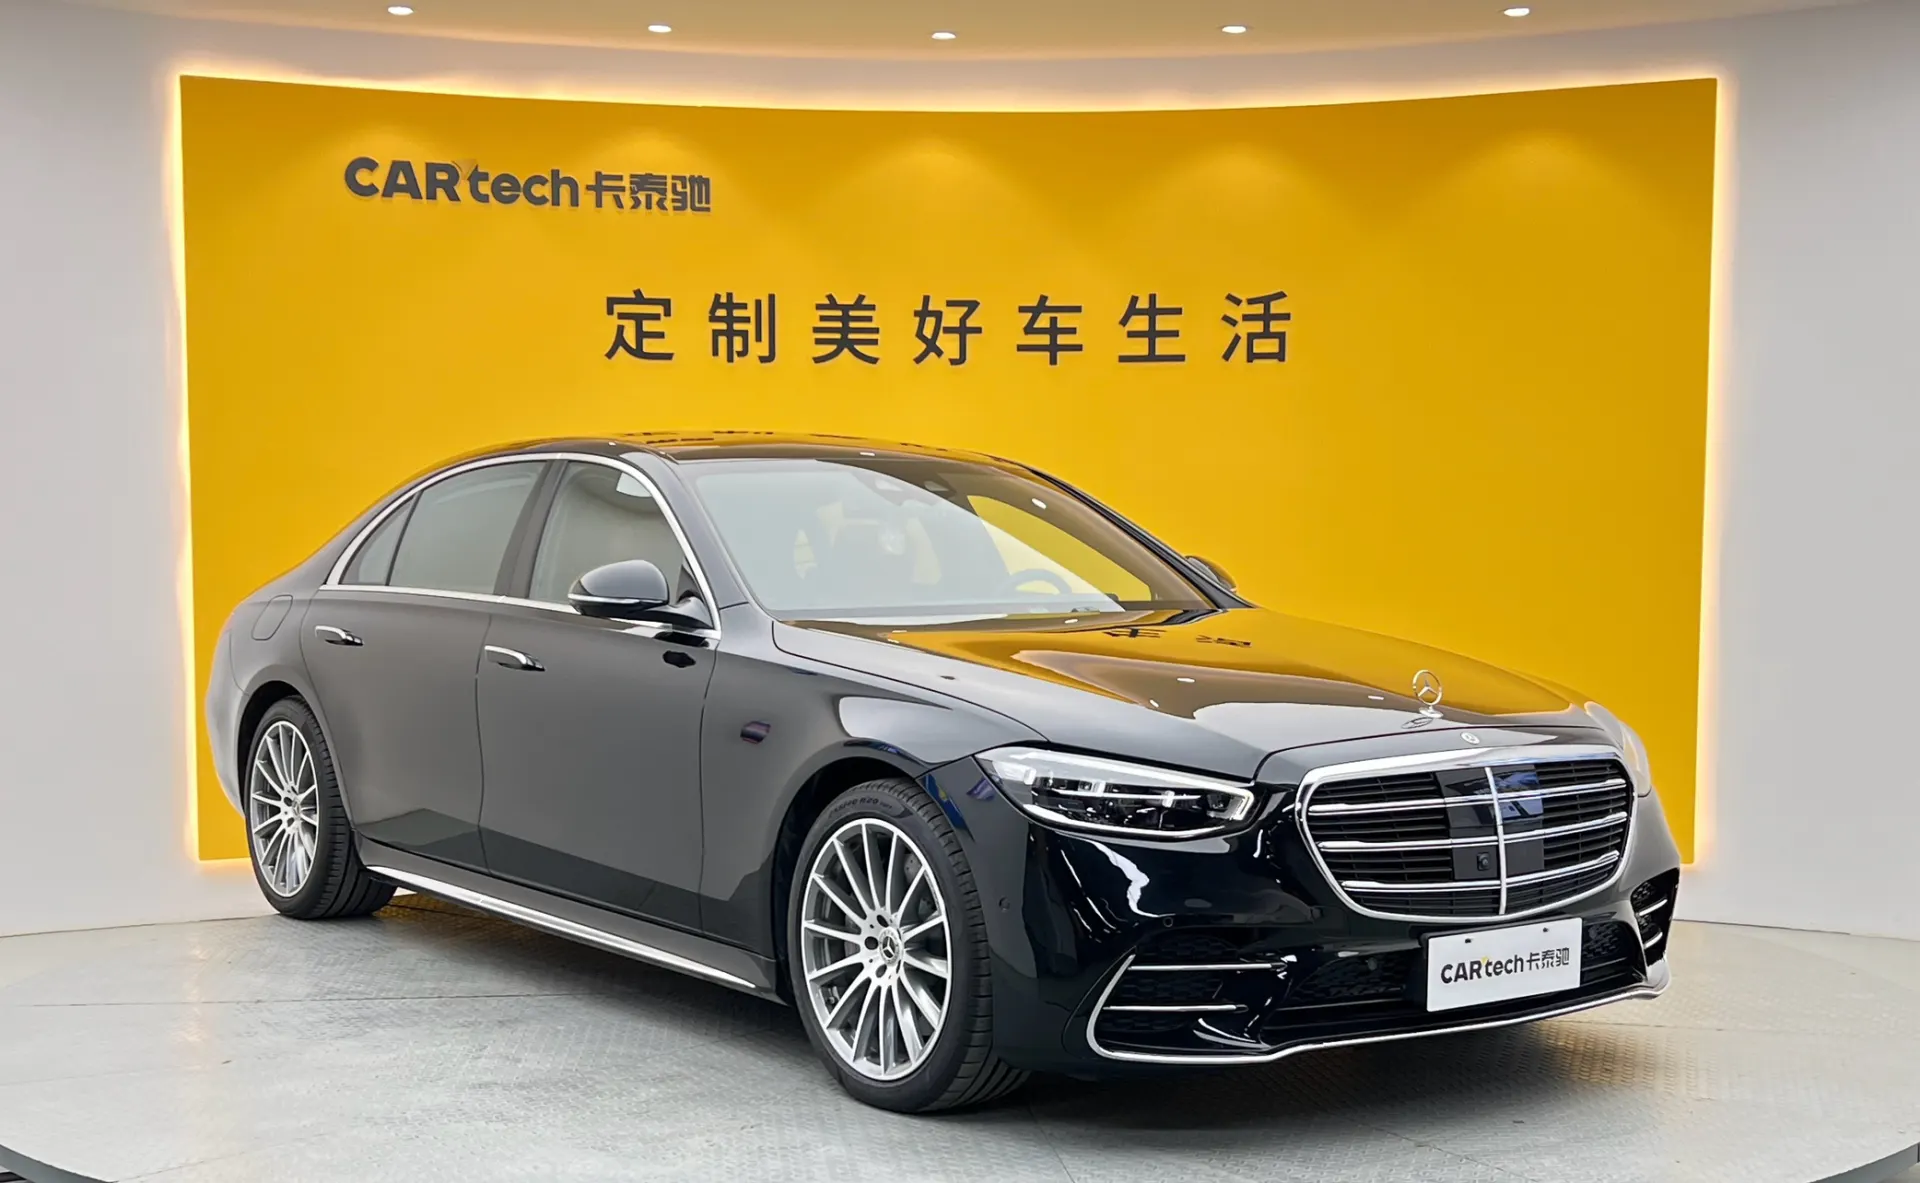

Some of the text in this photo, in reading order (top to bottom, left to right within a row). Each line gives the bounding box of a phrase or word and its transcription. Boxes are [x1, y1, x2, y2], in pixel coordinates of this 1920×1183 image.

[605, 288, 1292, 366] 定制美好车生活
